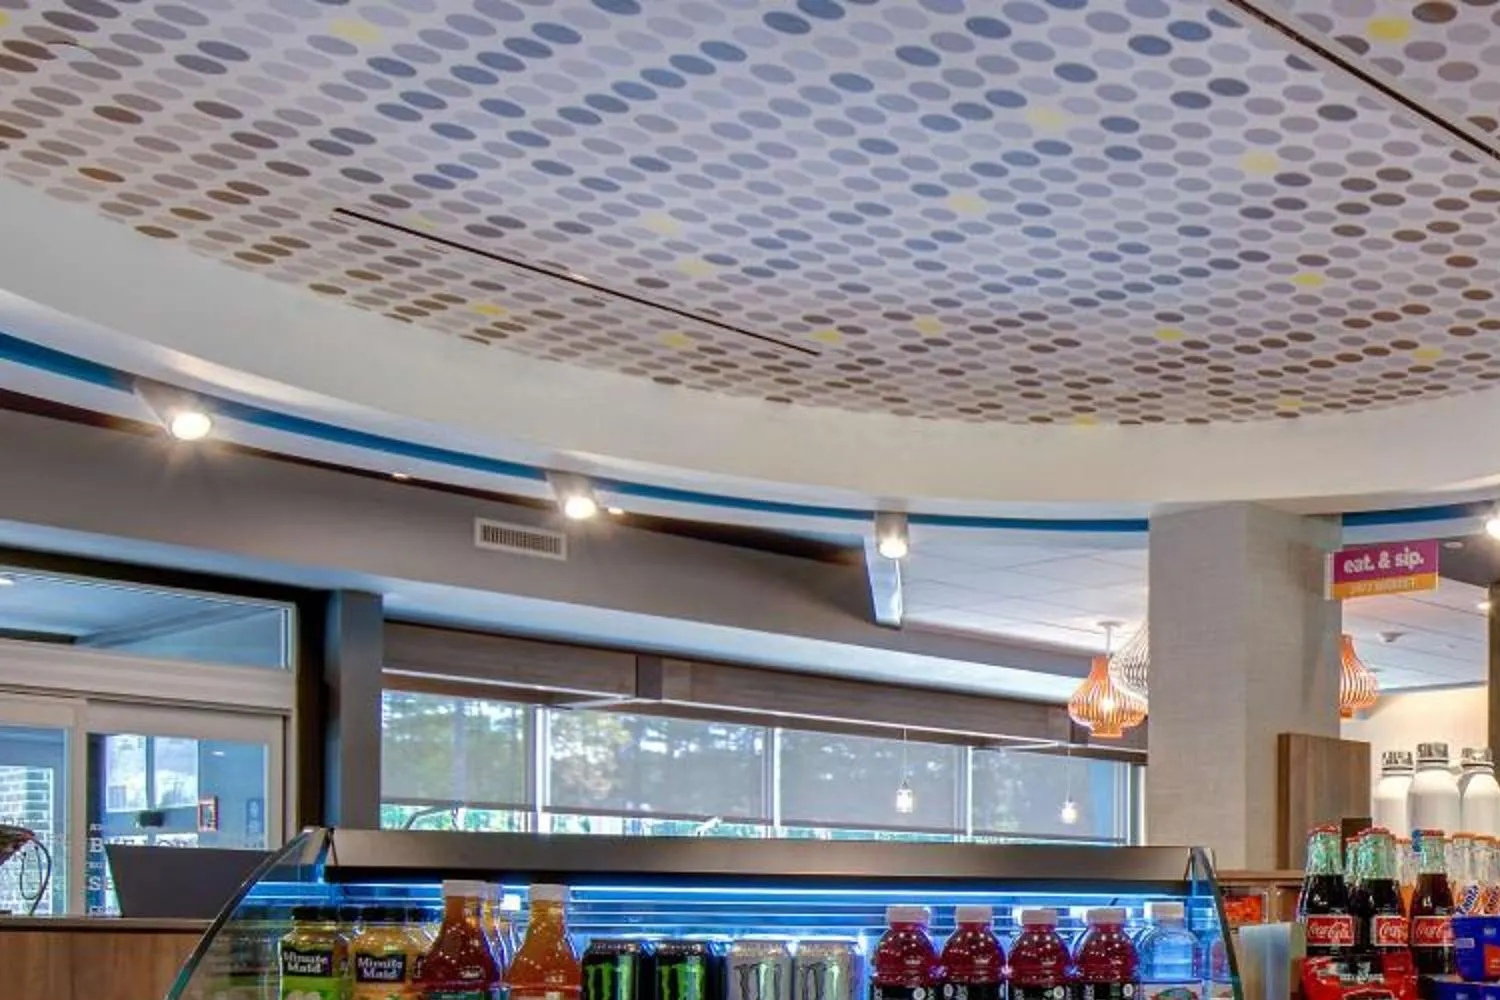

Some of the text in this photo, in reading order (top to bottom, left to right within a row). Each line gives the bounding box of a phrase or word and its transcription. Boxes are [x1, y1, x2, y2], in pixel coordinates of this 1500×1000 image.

[1343, 545, 1425, 573] eat. & sip.
[287, 961, 322, 974] Maid
